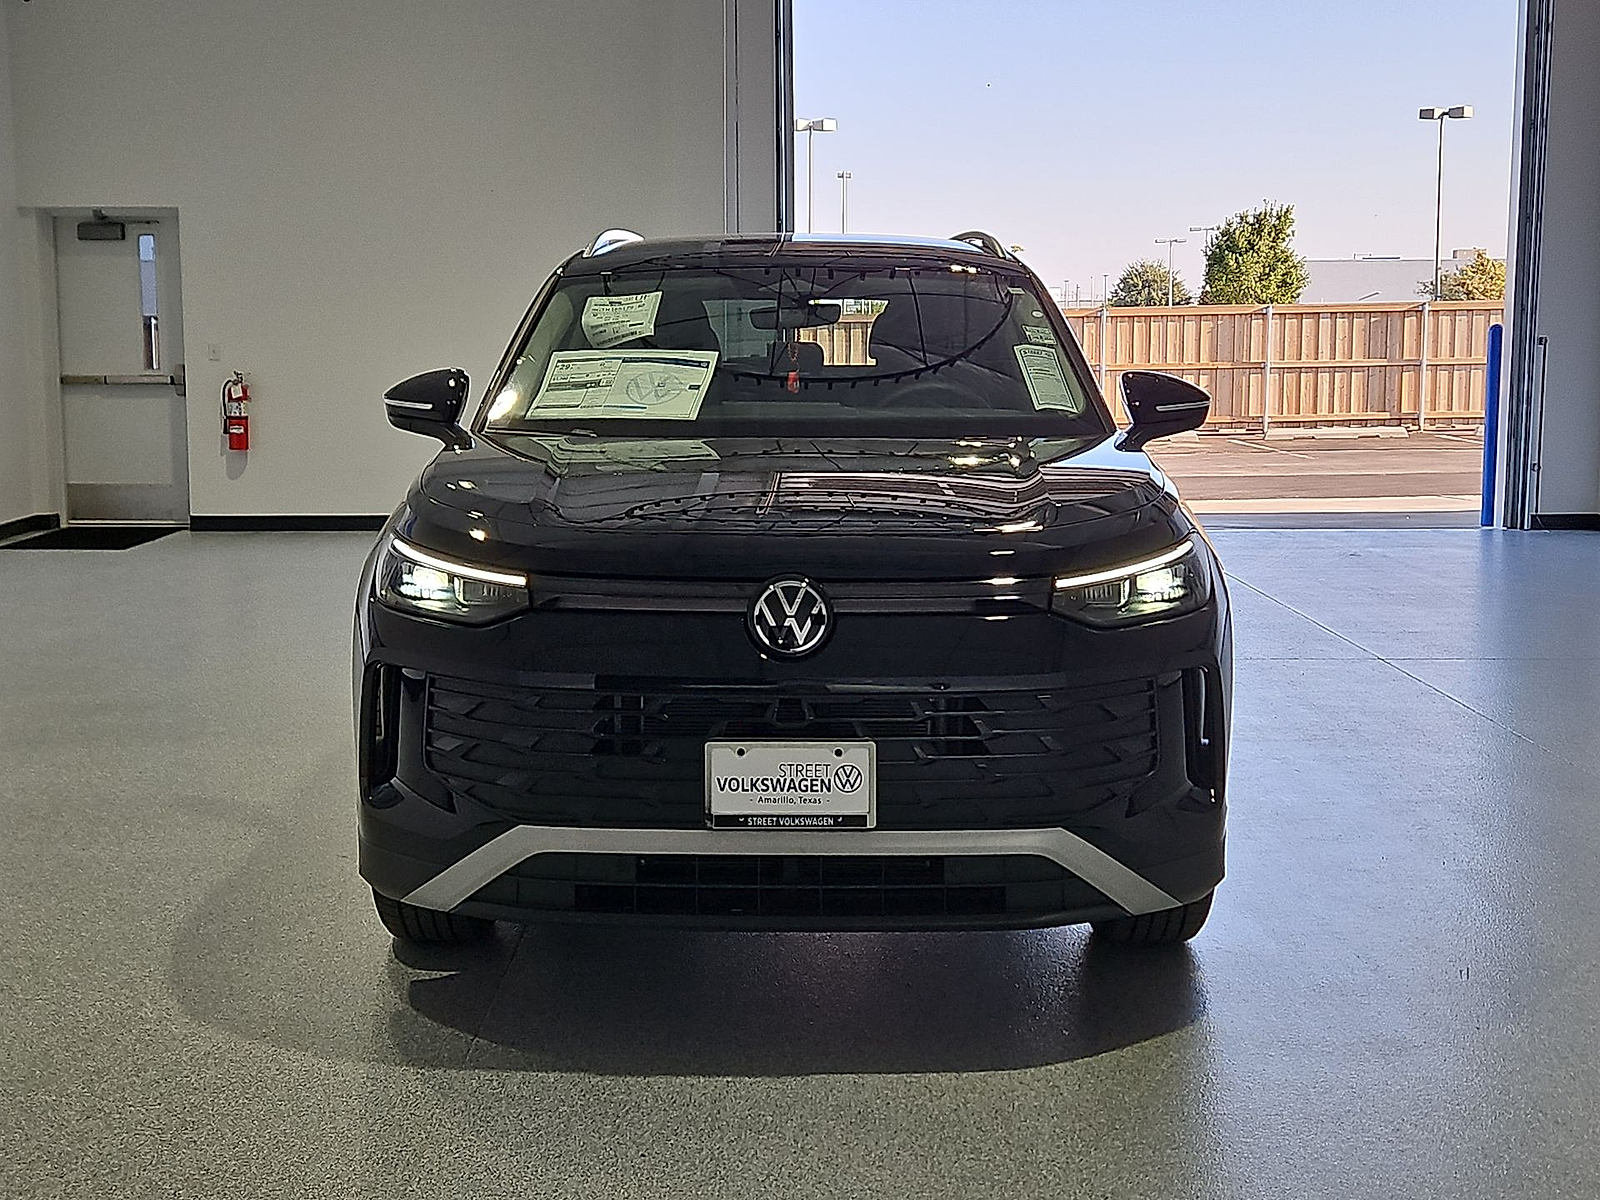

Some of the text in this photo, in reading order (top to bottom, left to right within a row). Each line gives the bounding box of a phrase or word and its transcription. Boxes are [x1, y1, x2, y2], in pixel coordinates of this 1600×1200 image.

[778, 763, 832, 778] STREET
[716, 777, 833, 793] VOLKSWAGEN
[757, 796, 822, 805] Amarillo, Texas
[747, 817, 834, 826] STREET VOLKSWAGEN
